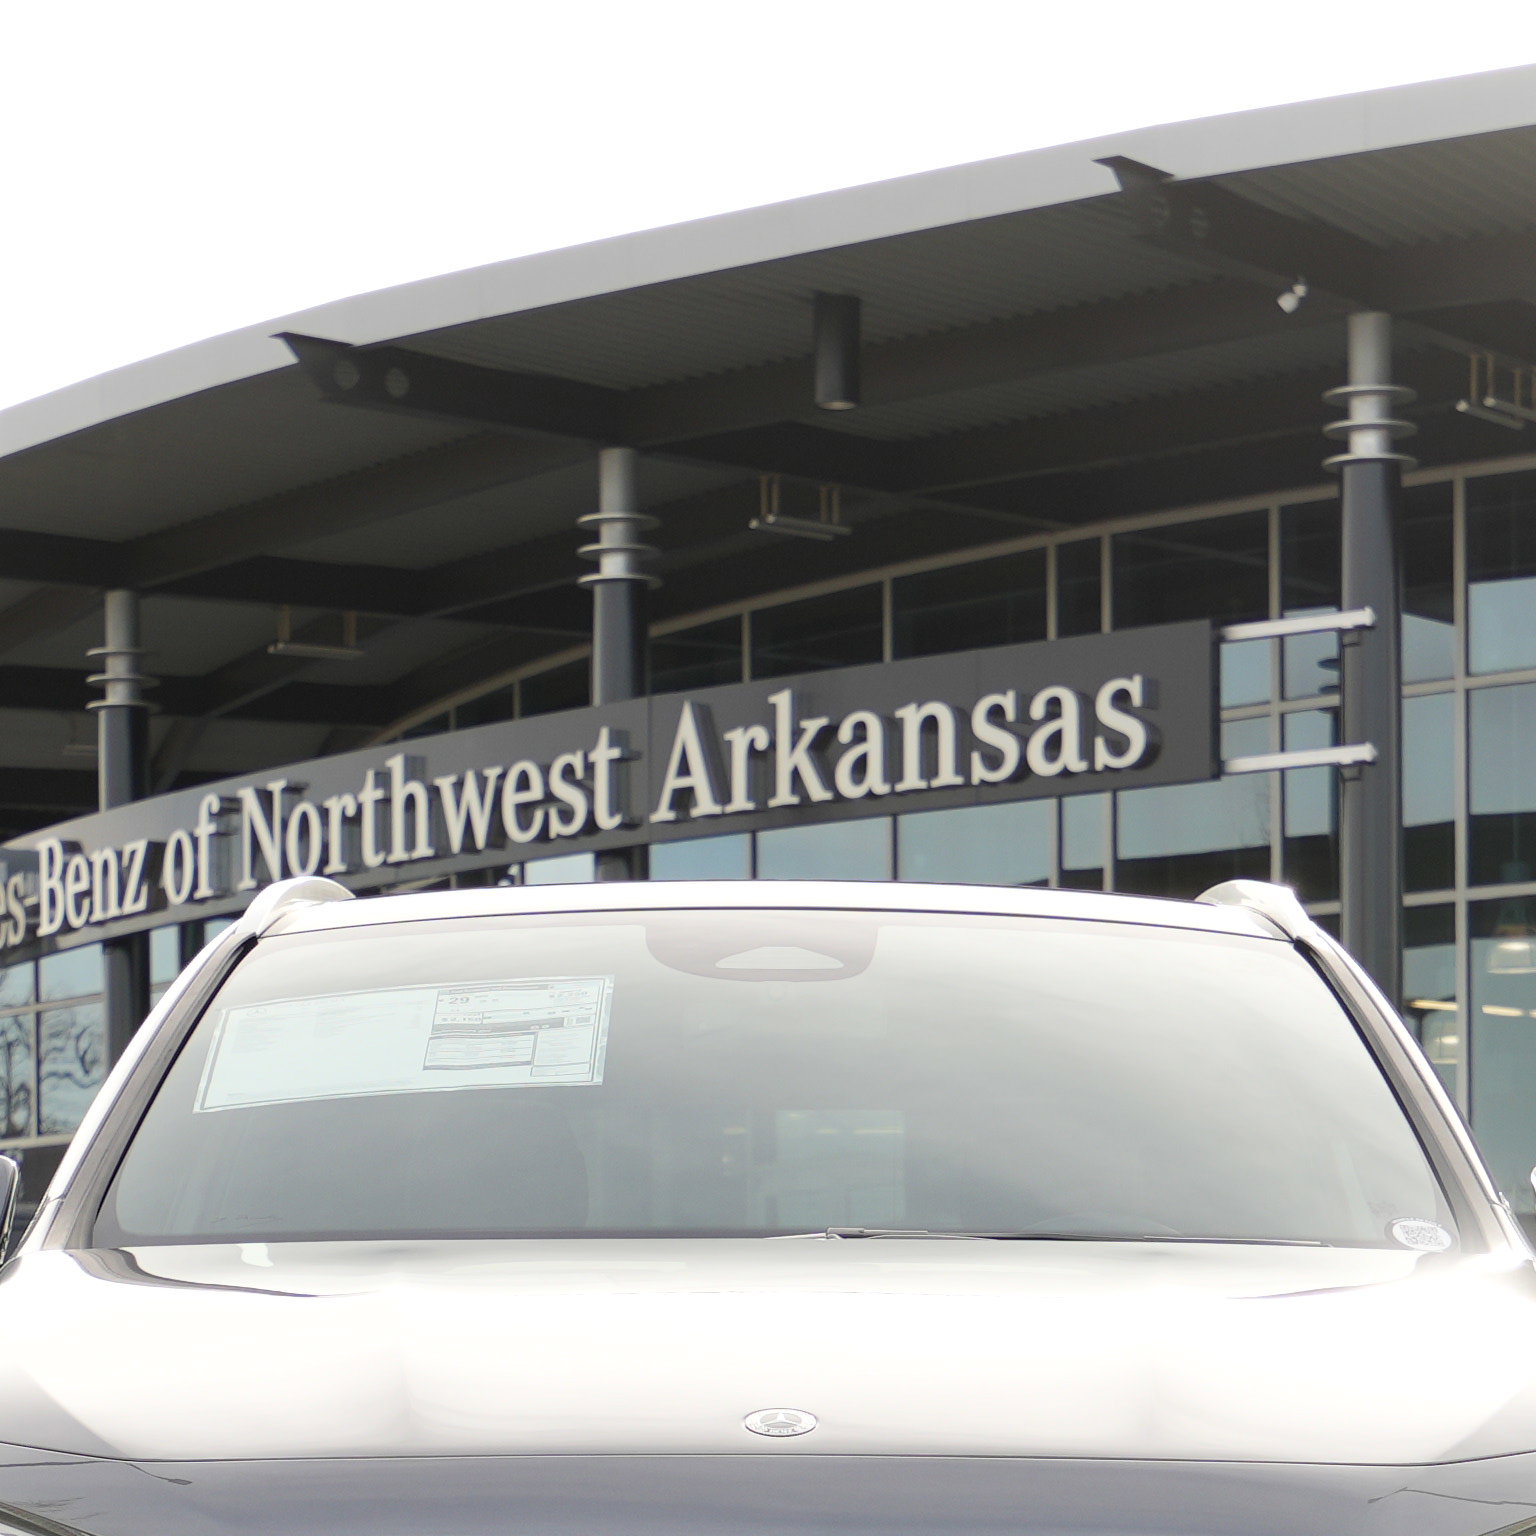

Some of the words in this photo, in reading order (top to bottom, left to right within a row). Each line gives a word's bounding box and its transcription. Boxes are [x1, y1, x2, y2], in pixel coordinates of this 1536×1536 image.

[163, 793, 219, 903] of
[238, 726, 623, 889] Northwest
[650, 674, 1149, 823] Arkansas
